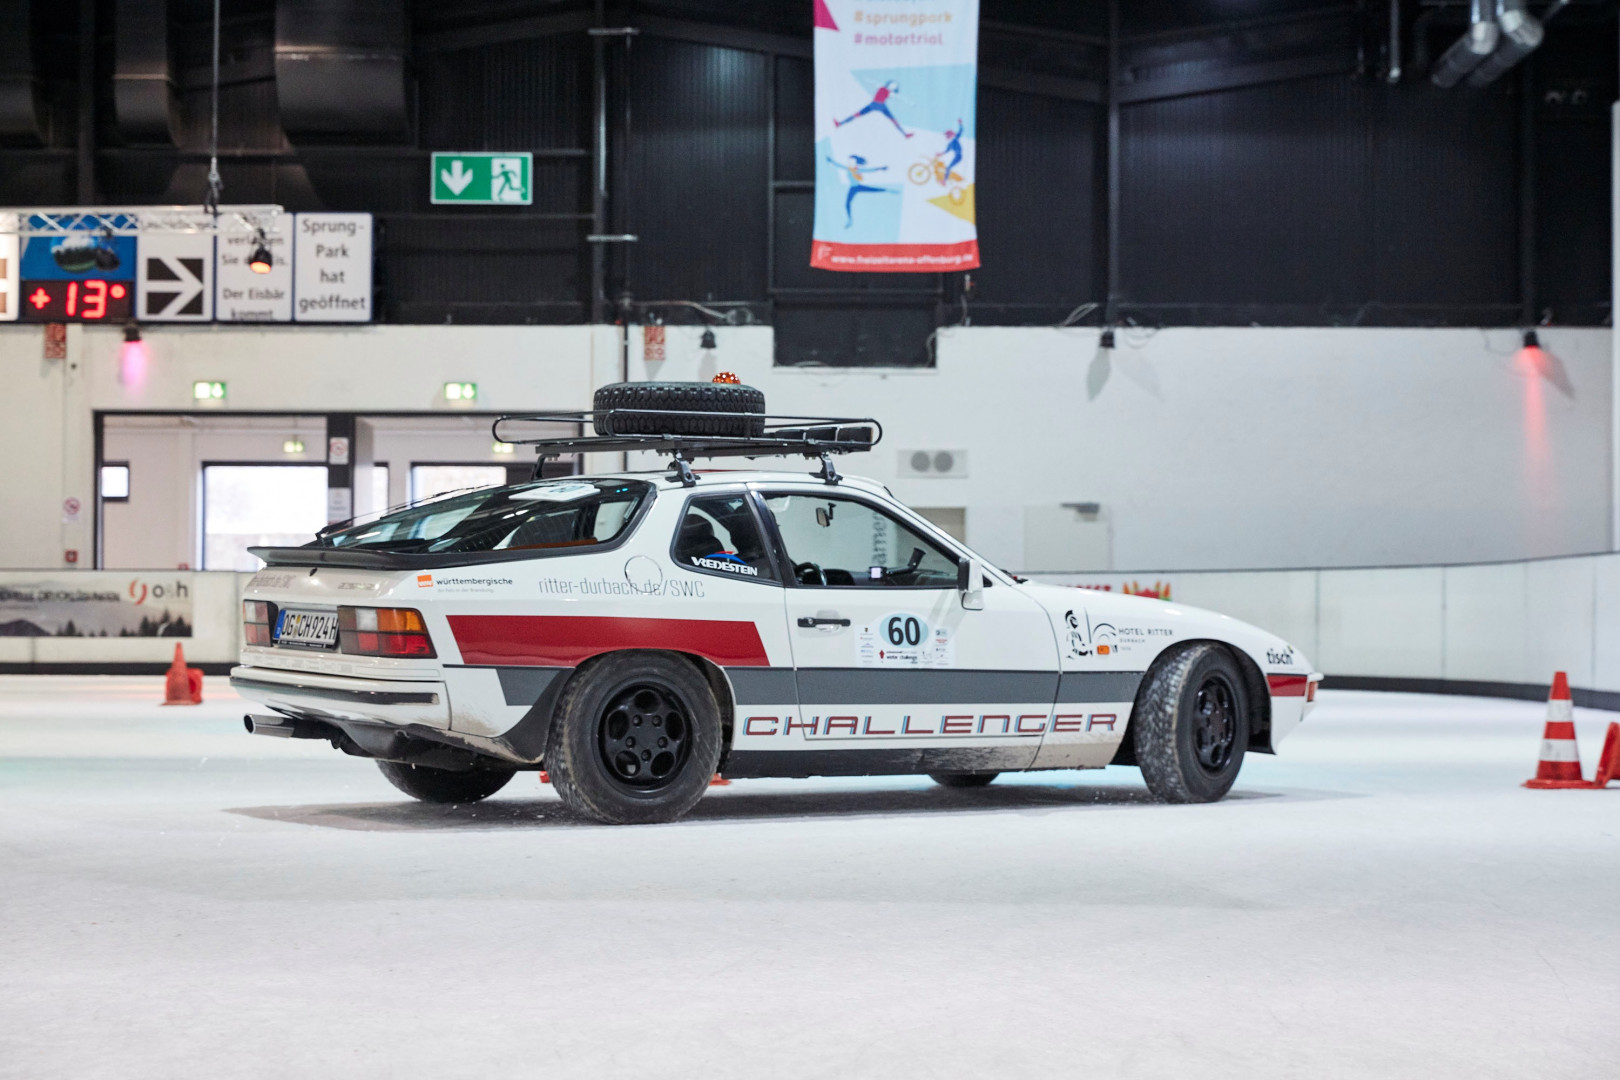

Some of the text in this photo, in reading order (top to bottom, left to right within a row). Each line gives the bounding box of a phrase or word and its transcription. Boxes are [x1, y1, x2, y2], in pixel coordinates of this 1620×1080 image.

[853, 32, 943, 46] #motortrial
[302, 219, 365, 236] Sprung-
[316, 244, 349, 258] Park
[222, 255, 239, 265] Sie
[320, 269, 345, 284] hat
[223, 287, 285, 299] Der Eisbär
[299, 295, 366, 313] geöffnet
[691, 556, 758, 577] VREDESTEIN
[436, 576, 513, 587] württembergische
[539, 577, 706, 598] ritter-durbach.de/SWC
[888, 616, 921, 646] 60
[1118, 627, 1174, 637] HOTEL RITTER
[1266, 647, 1293, 665] tisch
[742, 713, 1118, 736] CHALLENGER
